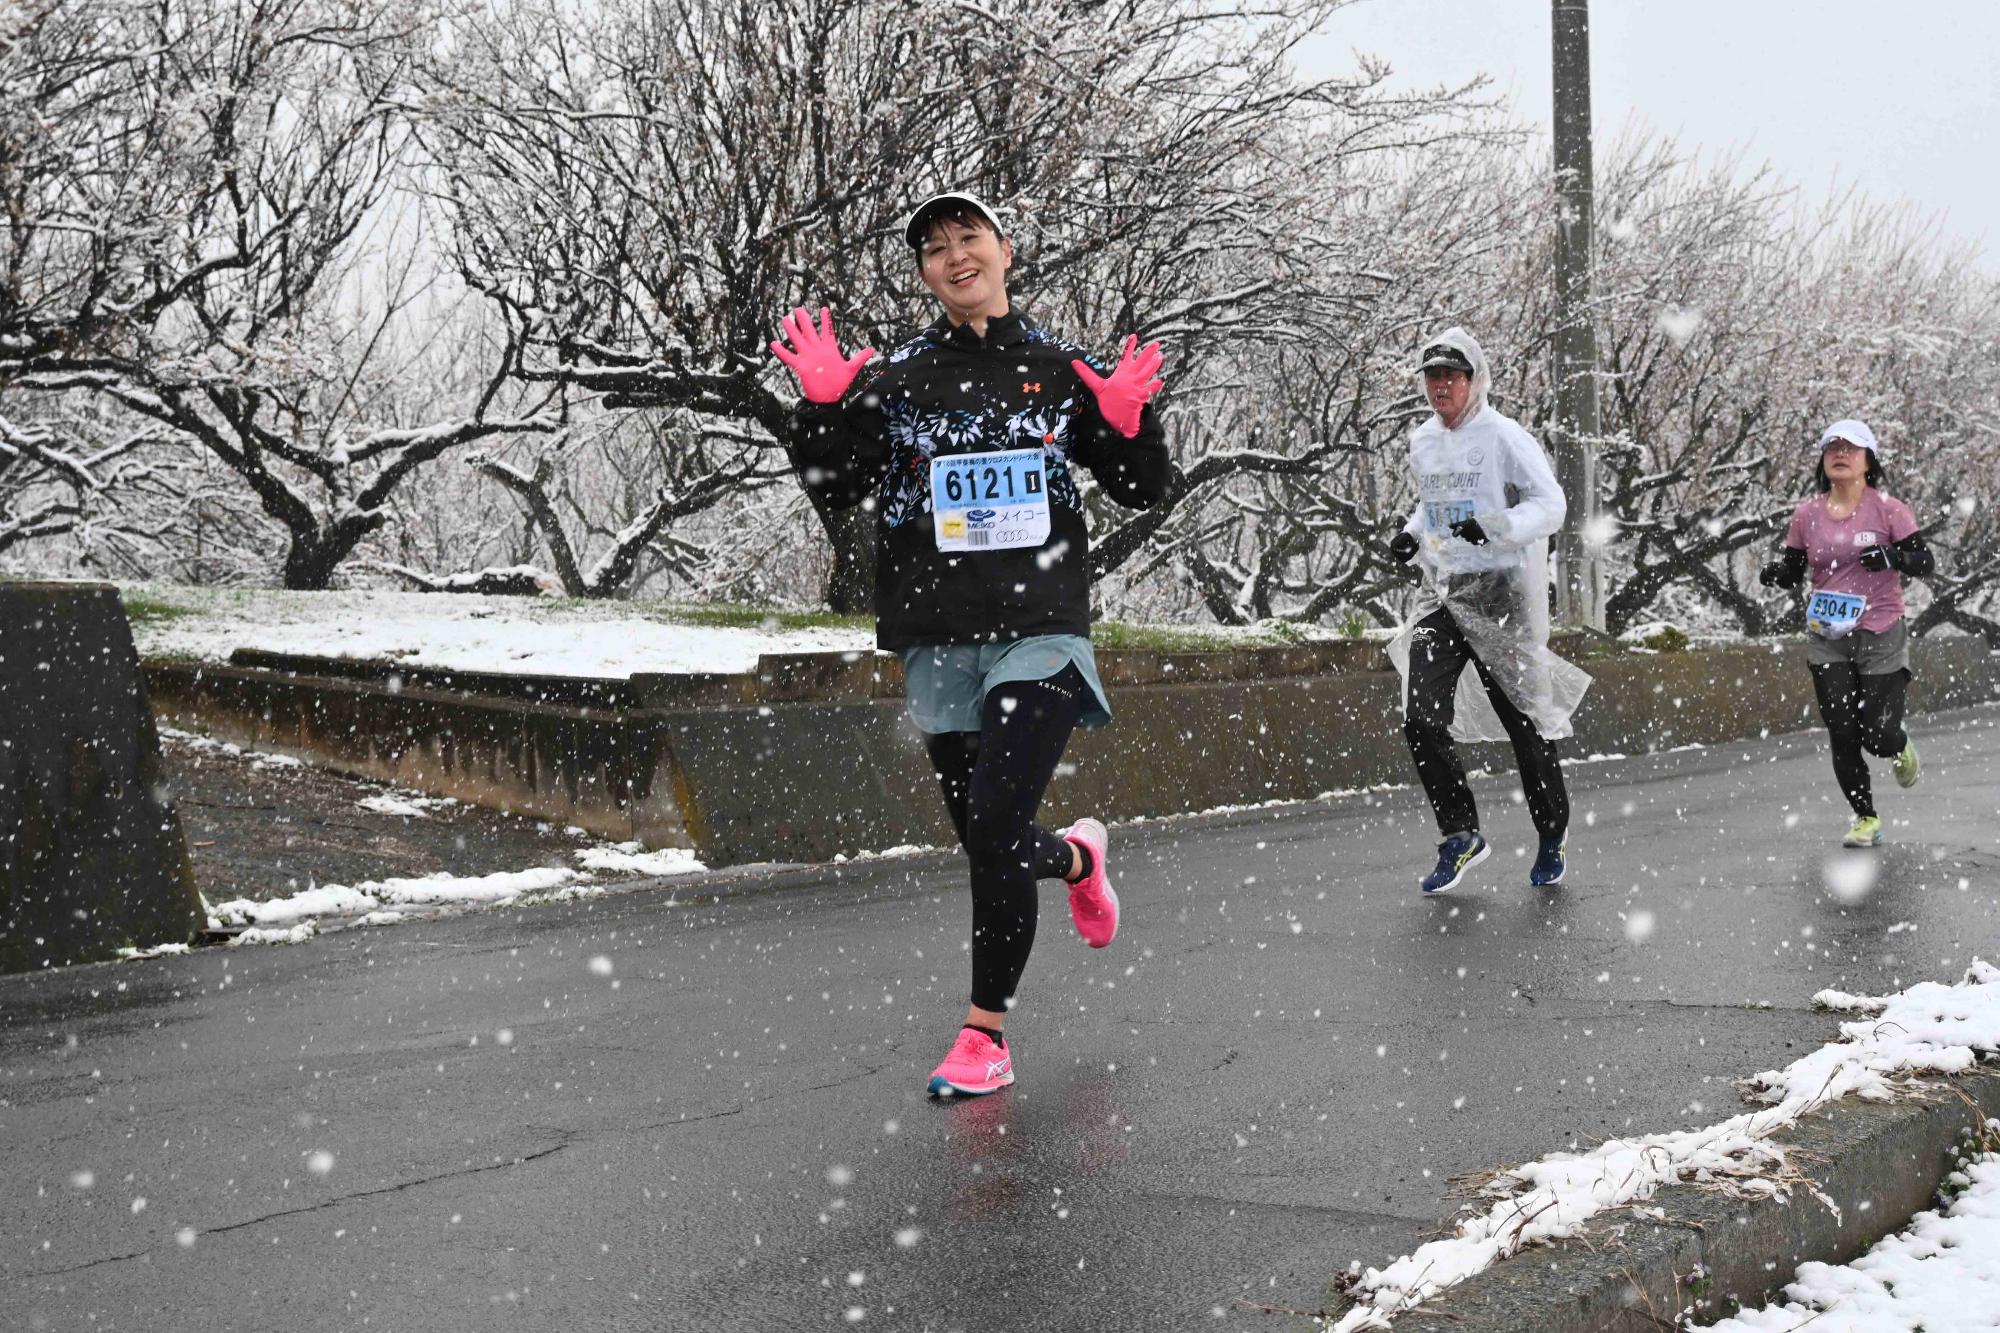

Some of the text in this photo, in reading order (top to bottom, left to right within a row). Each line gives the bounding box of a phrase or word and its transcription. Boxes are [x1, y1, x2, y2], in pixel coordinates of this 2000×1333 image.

[946, 466, 1014, 501] 6121
[1000, 510, 1046, 522] メイコー
